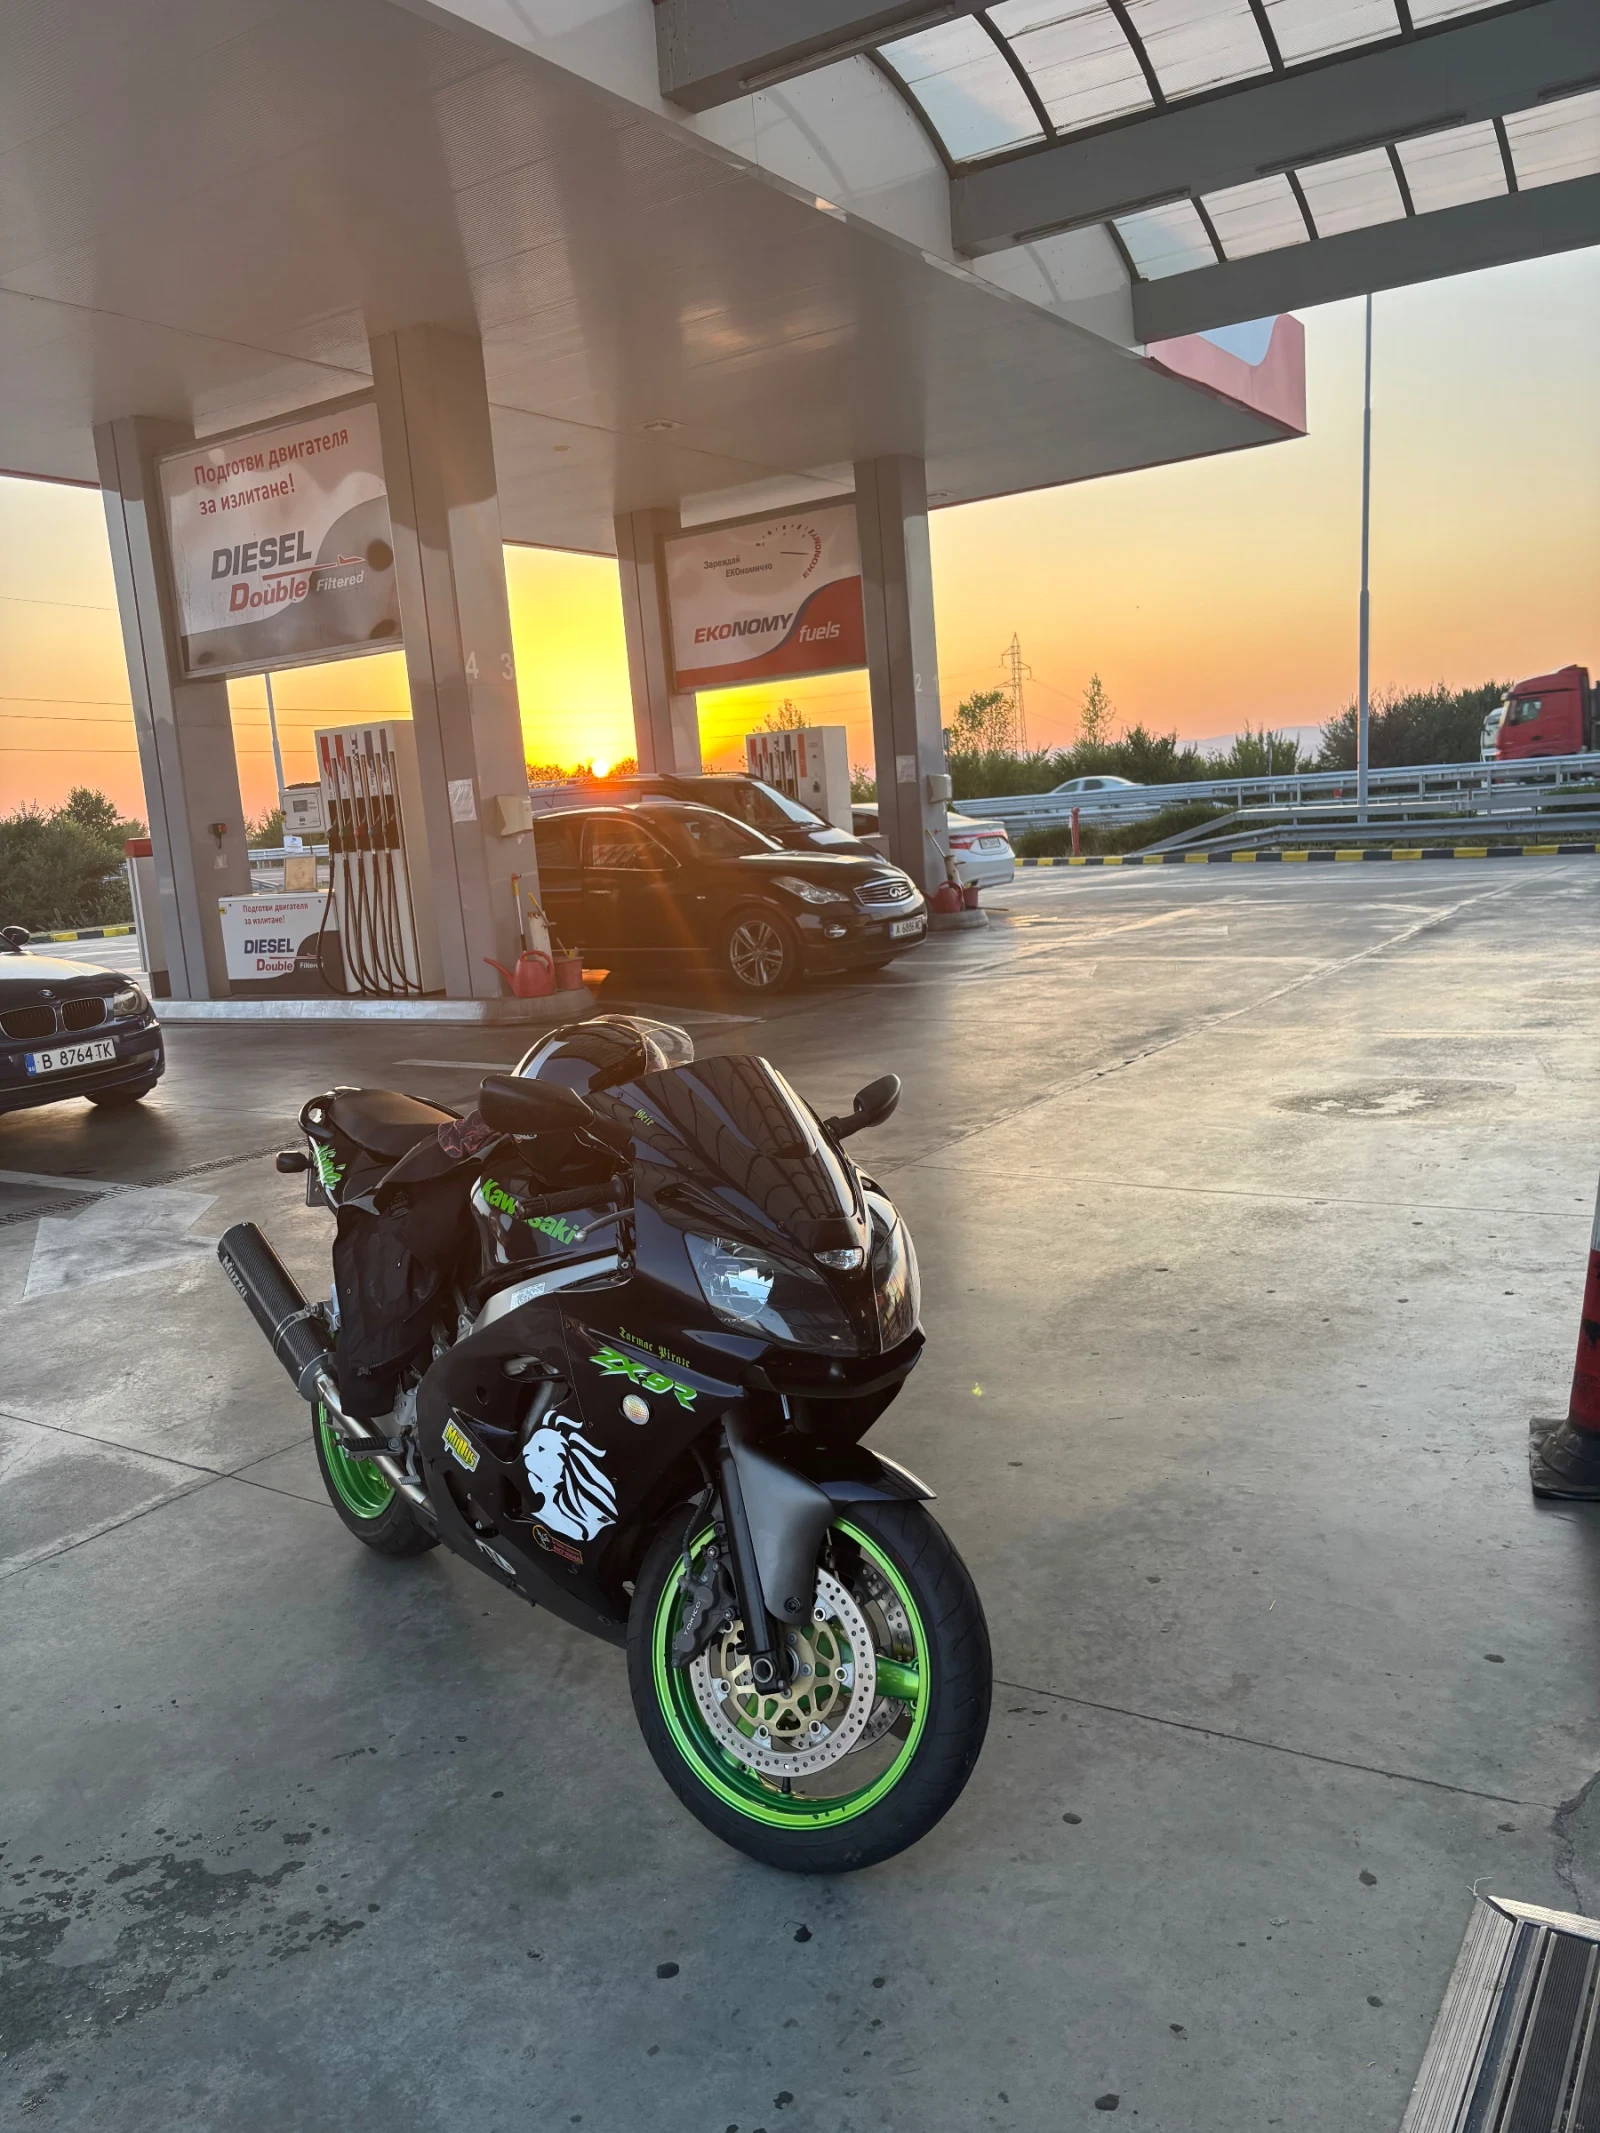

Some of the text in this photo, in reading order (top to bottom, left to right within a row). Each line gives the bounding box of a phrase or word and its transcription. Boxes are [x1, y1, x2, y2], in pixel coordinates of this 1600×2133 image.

[194, 429, 348, 485] Подготви двигателя
[199, 472, 295, 515] за излитане!
[211, 530, 312, 580] DIESEL
[703, 554, 741, 570] Зареждай
[229, 570, 364, 612] Double Filtered
[694, 613, 840, 644] EKONOMY fuels
[465, 651, 479, 679] 4
[500, 652, 514, 680] 3
[915, 673, 922, 692] 2
[243, 903, 308, 914] Подготви двигателя
[253, 915, 285, 924] излитане!
[244, 938, 294, 954] DIESEL
[256, 959, 293, 971] Double
[42, 1043, 113, 1070] B 8764 TK
[481, 1178, 580, 1245] Kawsaki
[683, 1601, 701, 1635] TOKICO
